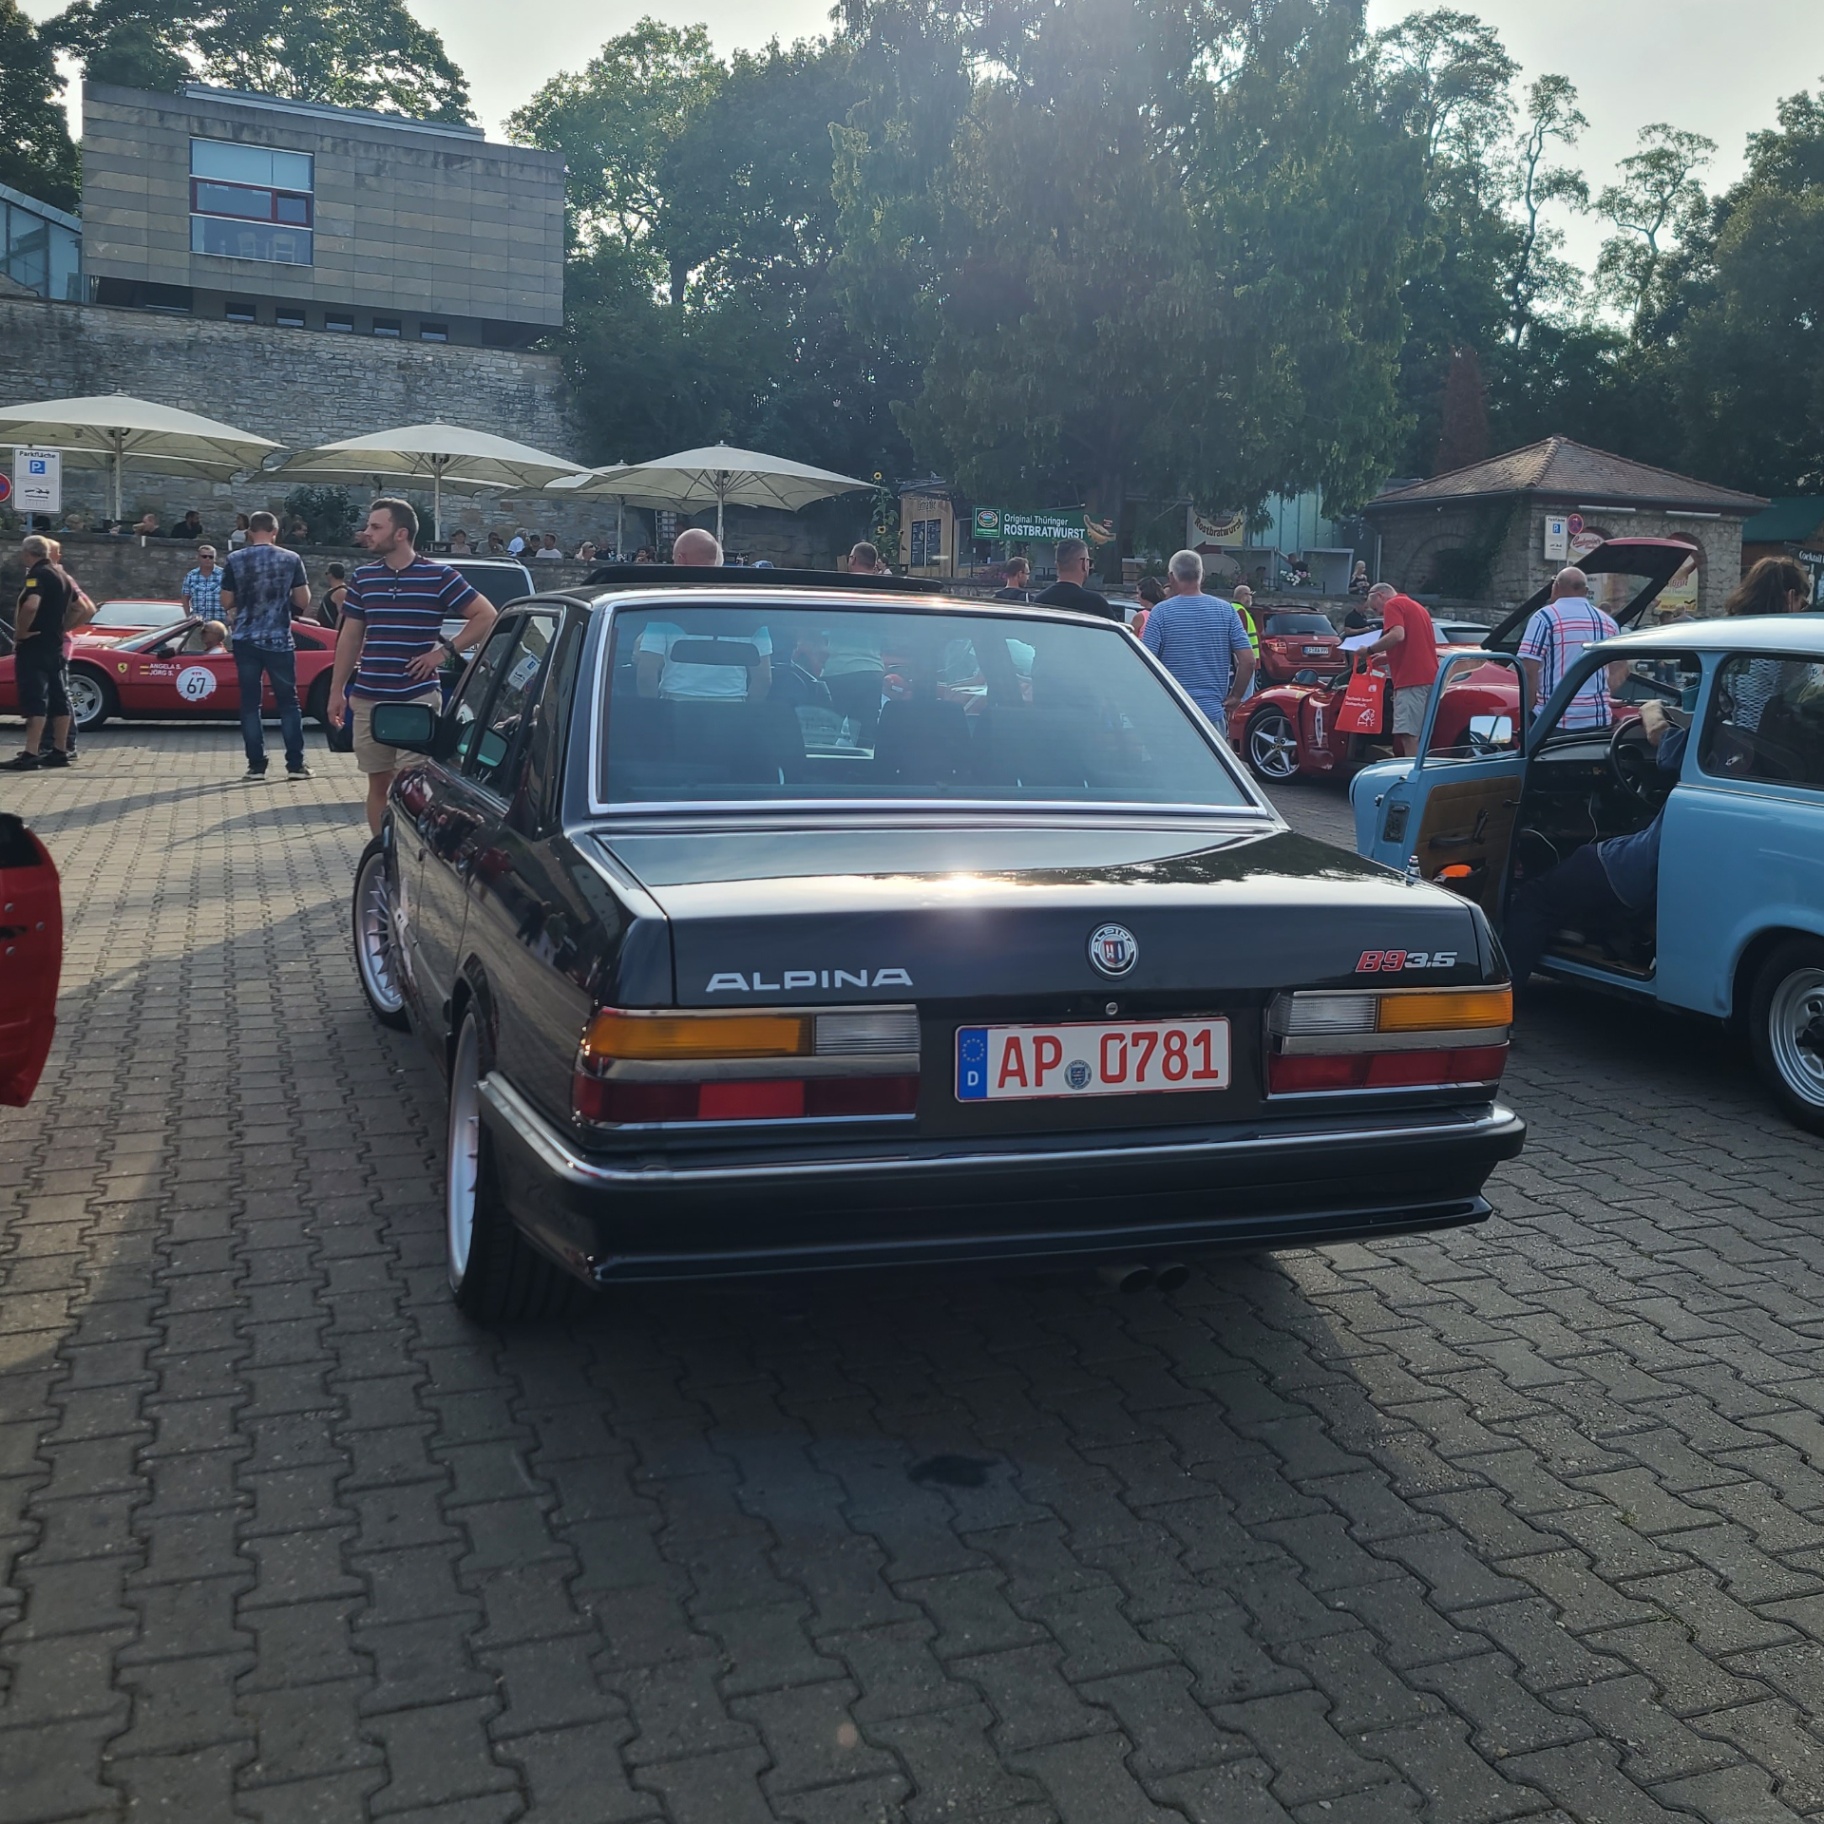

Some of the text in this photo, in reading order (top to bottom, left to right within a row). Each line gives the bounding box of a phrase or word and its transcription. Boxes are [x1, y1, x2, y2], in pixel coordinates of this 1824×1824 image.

[19, 450, 56, 459] Parkfläche
[1004, 513, 1033, 525] Original
[1034, 514, 1069, 527] Thüringer
[1194, 516, 1244, 538] Rostbratwurst
[1003, 523, 1086, 540] ROSTBRATWURST
[186, 677, 206, 695] 67
[705, 968, 914, 993] ALPINA
[967, 1070, 979, 1087] D
[997, 1035, 1063, 1089] AP
[1100, 1029, 1219, 1084] 0781
